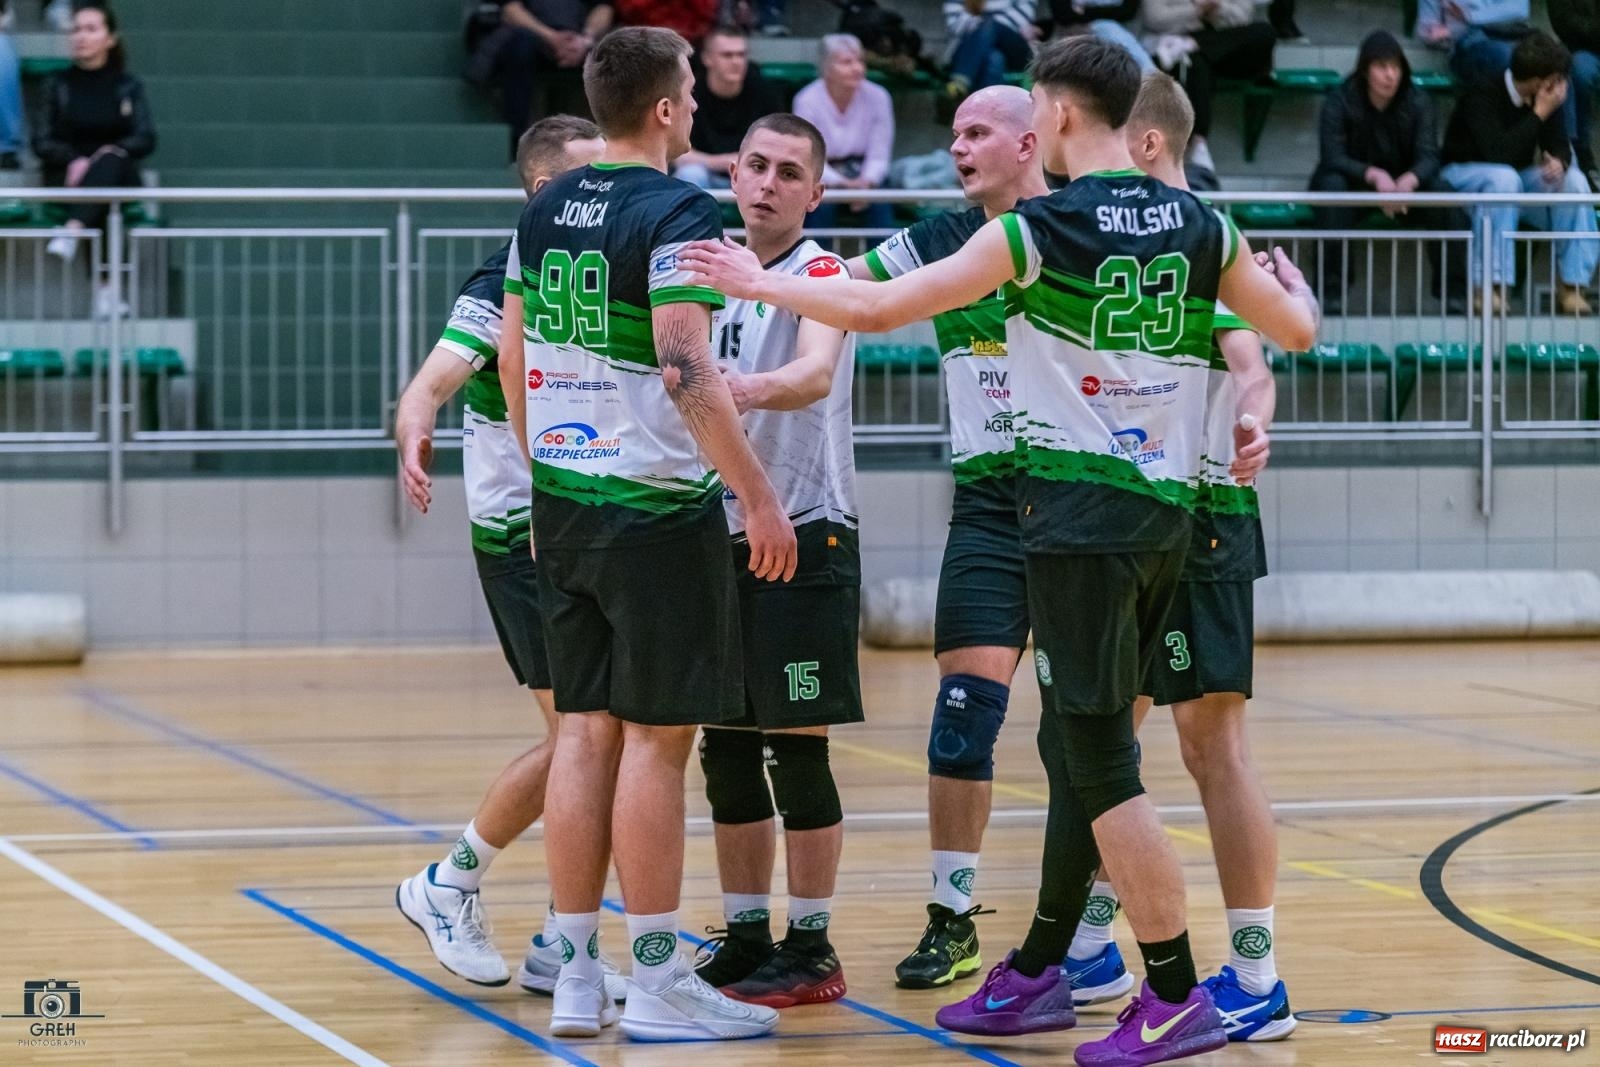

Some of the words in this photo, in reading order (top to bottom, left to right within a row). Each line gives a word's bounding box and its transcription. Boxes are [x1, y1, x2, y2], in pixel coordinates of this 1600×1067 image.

[554, 198, 609, 228] JOŃCA
[1096, 201, 1185, 236] SKULSKI
[535, 249, 610, 348] 99
[1091, 251, 1191, 351] 23
[718, 321, 744, 360] 15
[533, 447, 620, 460] UBEZPIECZENIA
[1165, 630, 1191, 671] 3
[784, 661, 820, 701] 15
